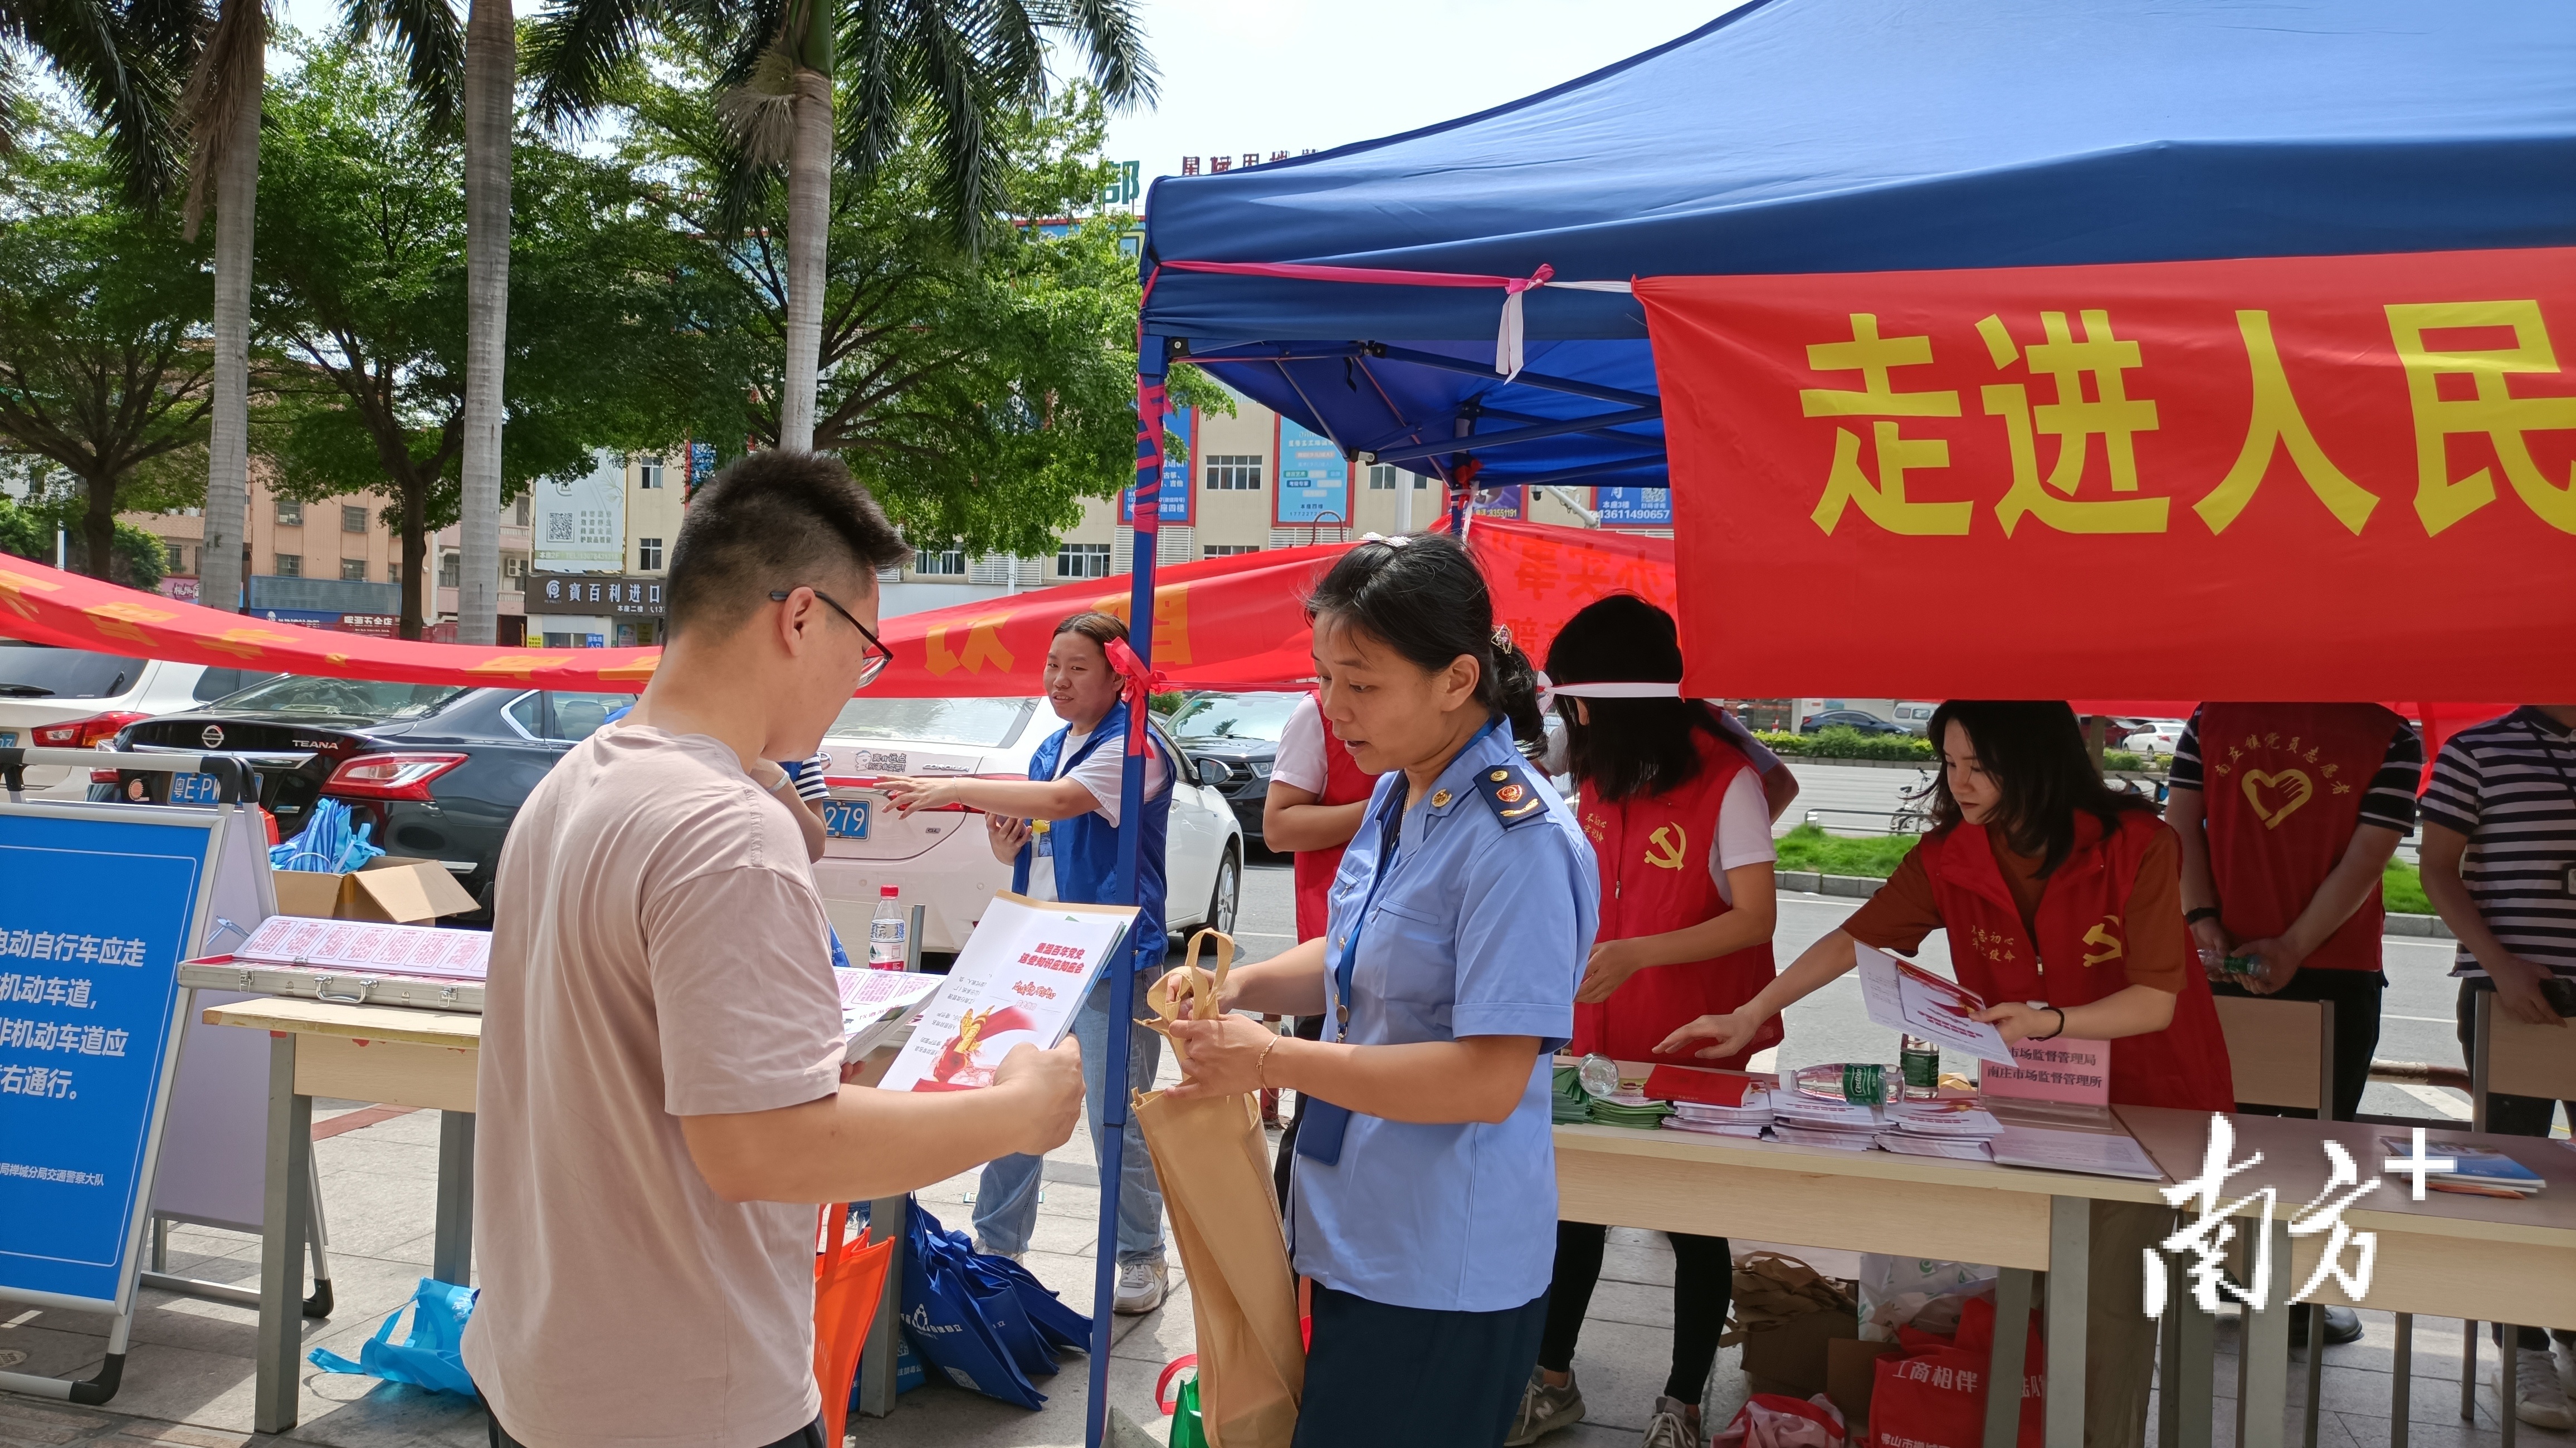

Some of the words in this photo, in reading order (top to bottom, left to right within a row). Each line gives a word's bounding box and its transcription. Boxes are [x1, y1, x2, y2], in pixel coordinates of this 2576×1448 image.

[1799, 300, 2576, 538] 走进人民
[1598, 509, 1670, 519] 13611490657
[292, 740, 339, 750] TEANA
[923, 764, 970, 772] COROLLA
[0, 972, 97, 1009] 机动车道，
[0, 1064, 77, 1100] 右通行。
[1987, 1065, 2102, 1088] 南庄市场监督管理所
[0, 1162, 104, 1187] 局禅城分局交通警察大队
[1892, 1360, 1978, 1393] 工商相伴
